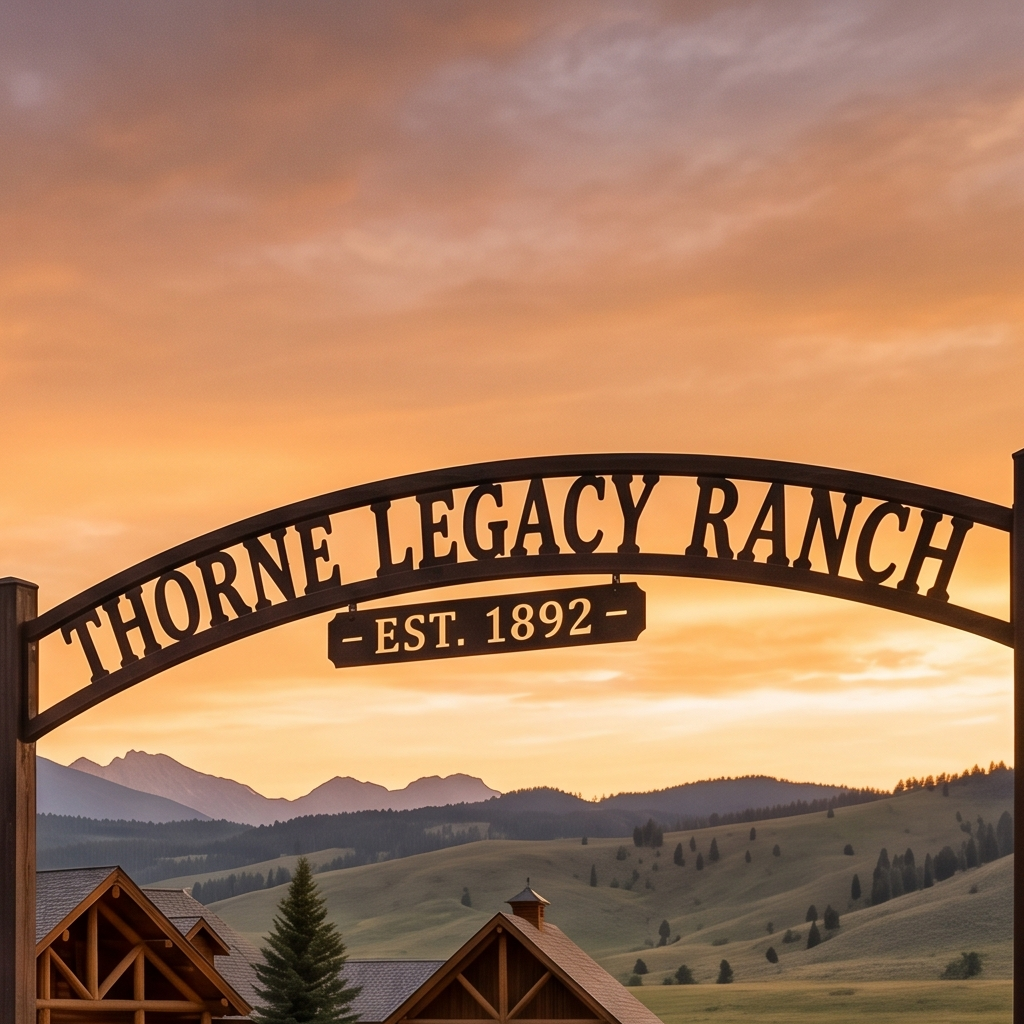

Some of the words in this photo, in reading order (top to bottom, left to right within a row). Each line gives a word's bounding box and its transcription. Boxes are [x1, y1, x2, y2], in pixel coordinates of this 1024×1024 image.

[61, 515, 341, 684] THORNE
[370, 475, 660, 577] LEGACY
[685, 476, 974, 603] RANCH
[375, 611, 465, 654] EST.
[486, 598, 592, 643] 1892
